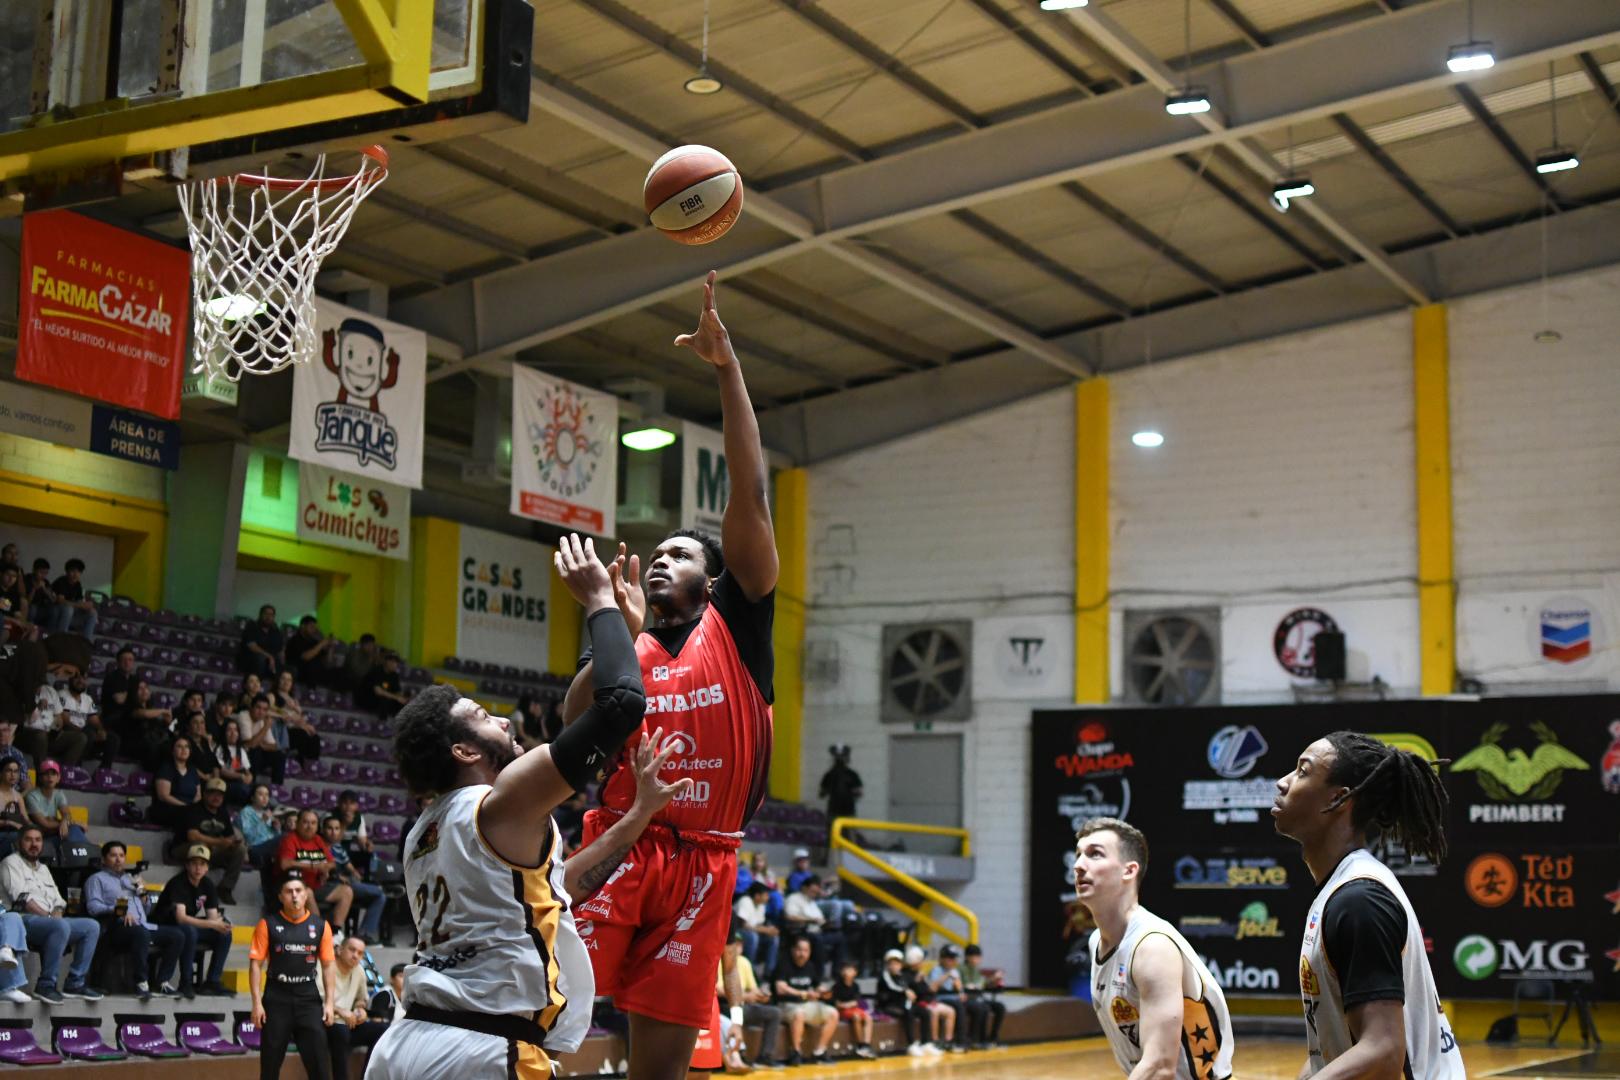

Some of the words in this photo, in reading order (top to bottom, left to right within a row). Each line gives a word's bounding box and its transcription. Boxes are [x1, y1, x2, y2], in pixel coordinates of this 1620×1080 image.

[680, 194, 703, 213] FIBA
[56, 250, 156, 292] FARMACIAS
[45, 322, 71, 339] MEJOR
[72, 329, 106, 349] SURTIDO
[106, 340, 116, 352] AL
[117, 343, 142, 360] MEJOR
[109, 413, 144, 438] ÁREA
[148, 427, 165, 444] DE
[321, 407, 395, 460] Tanque
[111, 438, 161, 463] PRENSA
[463, 557, 523, 591] CASAS
[462, 586, 546, 622] GRANDES
[678, 758, 723, 771] Azteca
[1055, 753, 1135, 777] WANDA
[1469, 804, 1566, 823] PEIMBERT
[1522, 882, 1575, 908] Kta
[1500, 939, 1590, 972] MG
[1209, 959, 1280, 989] Arion
[62, 1028, 78, 1039] R14
[126, 1025, 141, 1036] R15
[186, 1026, 200, 1036] R16
[242, 1023, 255, 1032] R17
